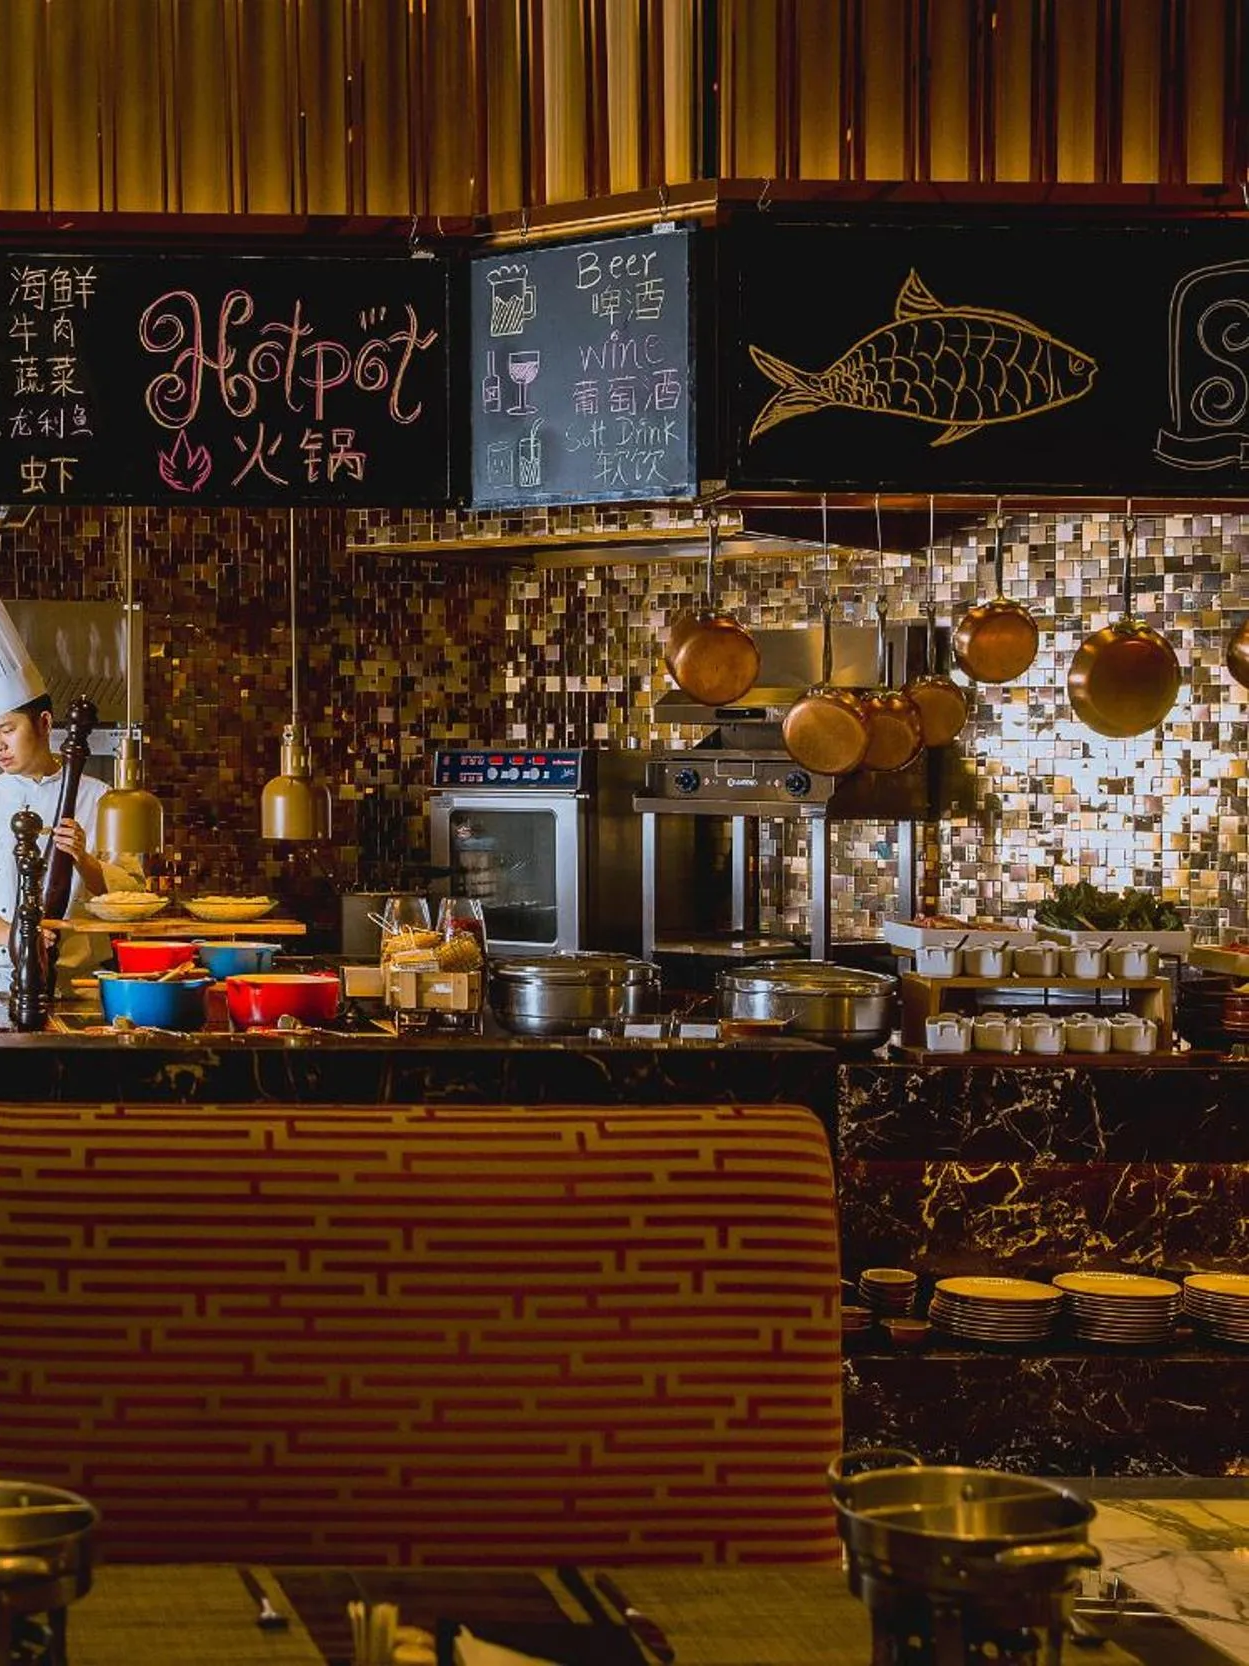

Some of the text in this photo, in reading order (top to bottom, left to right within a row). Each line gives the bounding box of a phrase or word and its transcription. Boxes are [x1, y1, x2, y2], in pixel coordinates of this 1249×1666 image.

[8, 265, 98, 312] 海鲜
[574, 251, 657, 290] Beer
[591, 278, 665, 325] 啤酒
[8, 312, 75, 352] 牛肉
[10, 354, 85, 397] 蔬菜
[138, 289, 439, 430] Hotpot
[571, 368, 682, 416] 葡萄酒
[8, 403, 95, 439] 龙利鱼
[565, 416, 681, 453] Soft Drink
[20, 455, 79, 494] 虾
[230, 421, 367, 488] 火锅
[592, 449, 671, 487] 软饮
